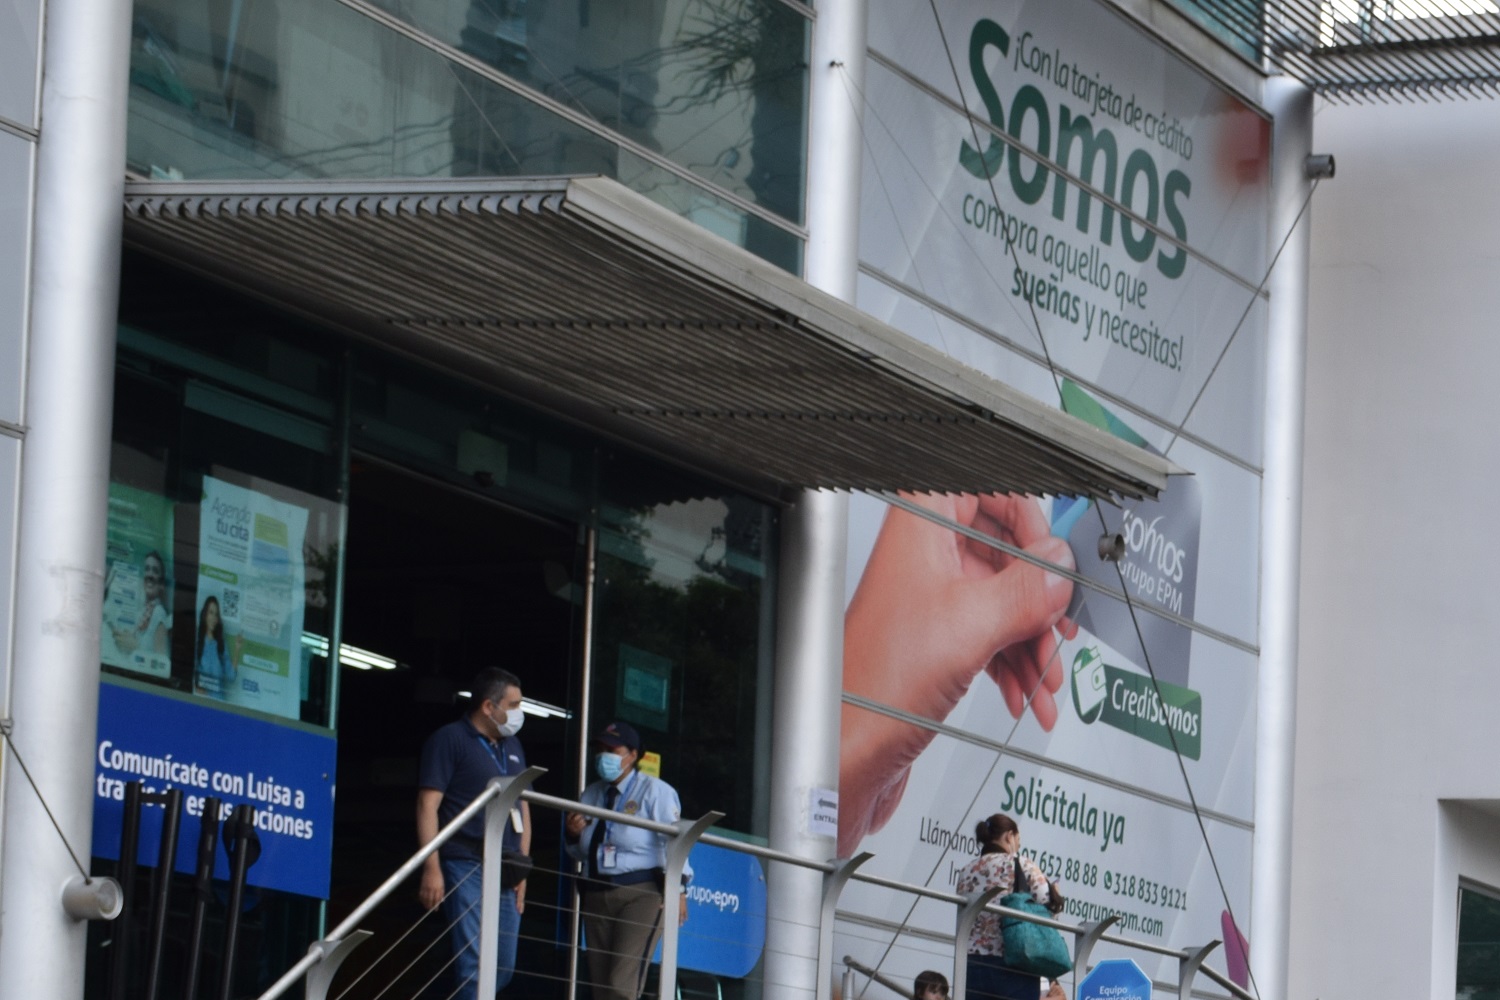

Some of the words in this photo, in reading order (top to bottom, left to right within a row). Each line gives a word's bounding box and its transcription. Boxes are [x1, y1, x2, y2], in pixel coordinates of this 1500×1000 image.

[1014, 31, 1050, 80] ¡Con
[1054, 49, 1069, 90] la
[1072, 63, 1122, 119] tarjeta
[1124, 94, 1143, 131] de
[1144, 112, 1193, 160] crédito
[959, 17, 1192, 280] Somos
[963, 194, 1038, 255] compra
[1043, 234, 1110, 292] aquello
[1115, 271, 1147, 311] que
[1012, 267, 1080, 324] sueñas
[1083, 301, 1096, 342] y
[1100, 308, 1184, 372] necesitas!
[1156, 578, 1182, 615] EPM
[1112, 678, 1198, 737] CrediSomos
[98, 741, 209, 788] Comunícate
[212, 770, 243, 796] con
[247, 773, 291, 806] Luisa
[295, 789, 305, 809] a
[252, 806, 313, 840] ciones
[1001, 770, 1098, 837] Solicítala
[1100, 811, 1125, 852] ya
[1039, 851, 1061, 878] 652
[1064, 858, 1080, 883] 88
[1082, 863, 1098, 887] 88
[1113, 873, 1136, 897] 318
[1138, 879, 1158, 905] 833
[1161, 885, 1187, 910] 9121
[1099, 985, 1128, 996] Equipo
